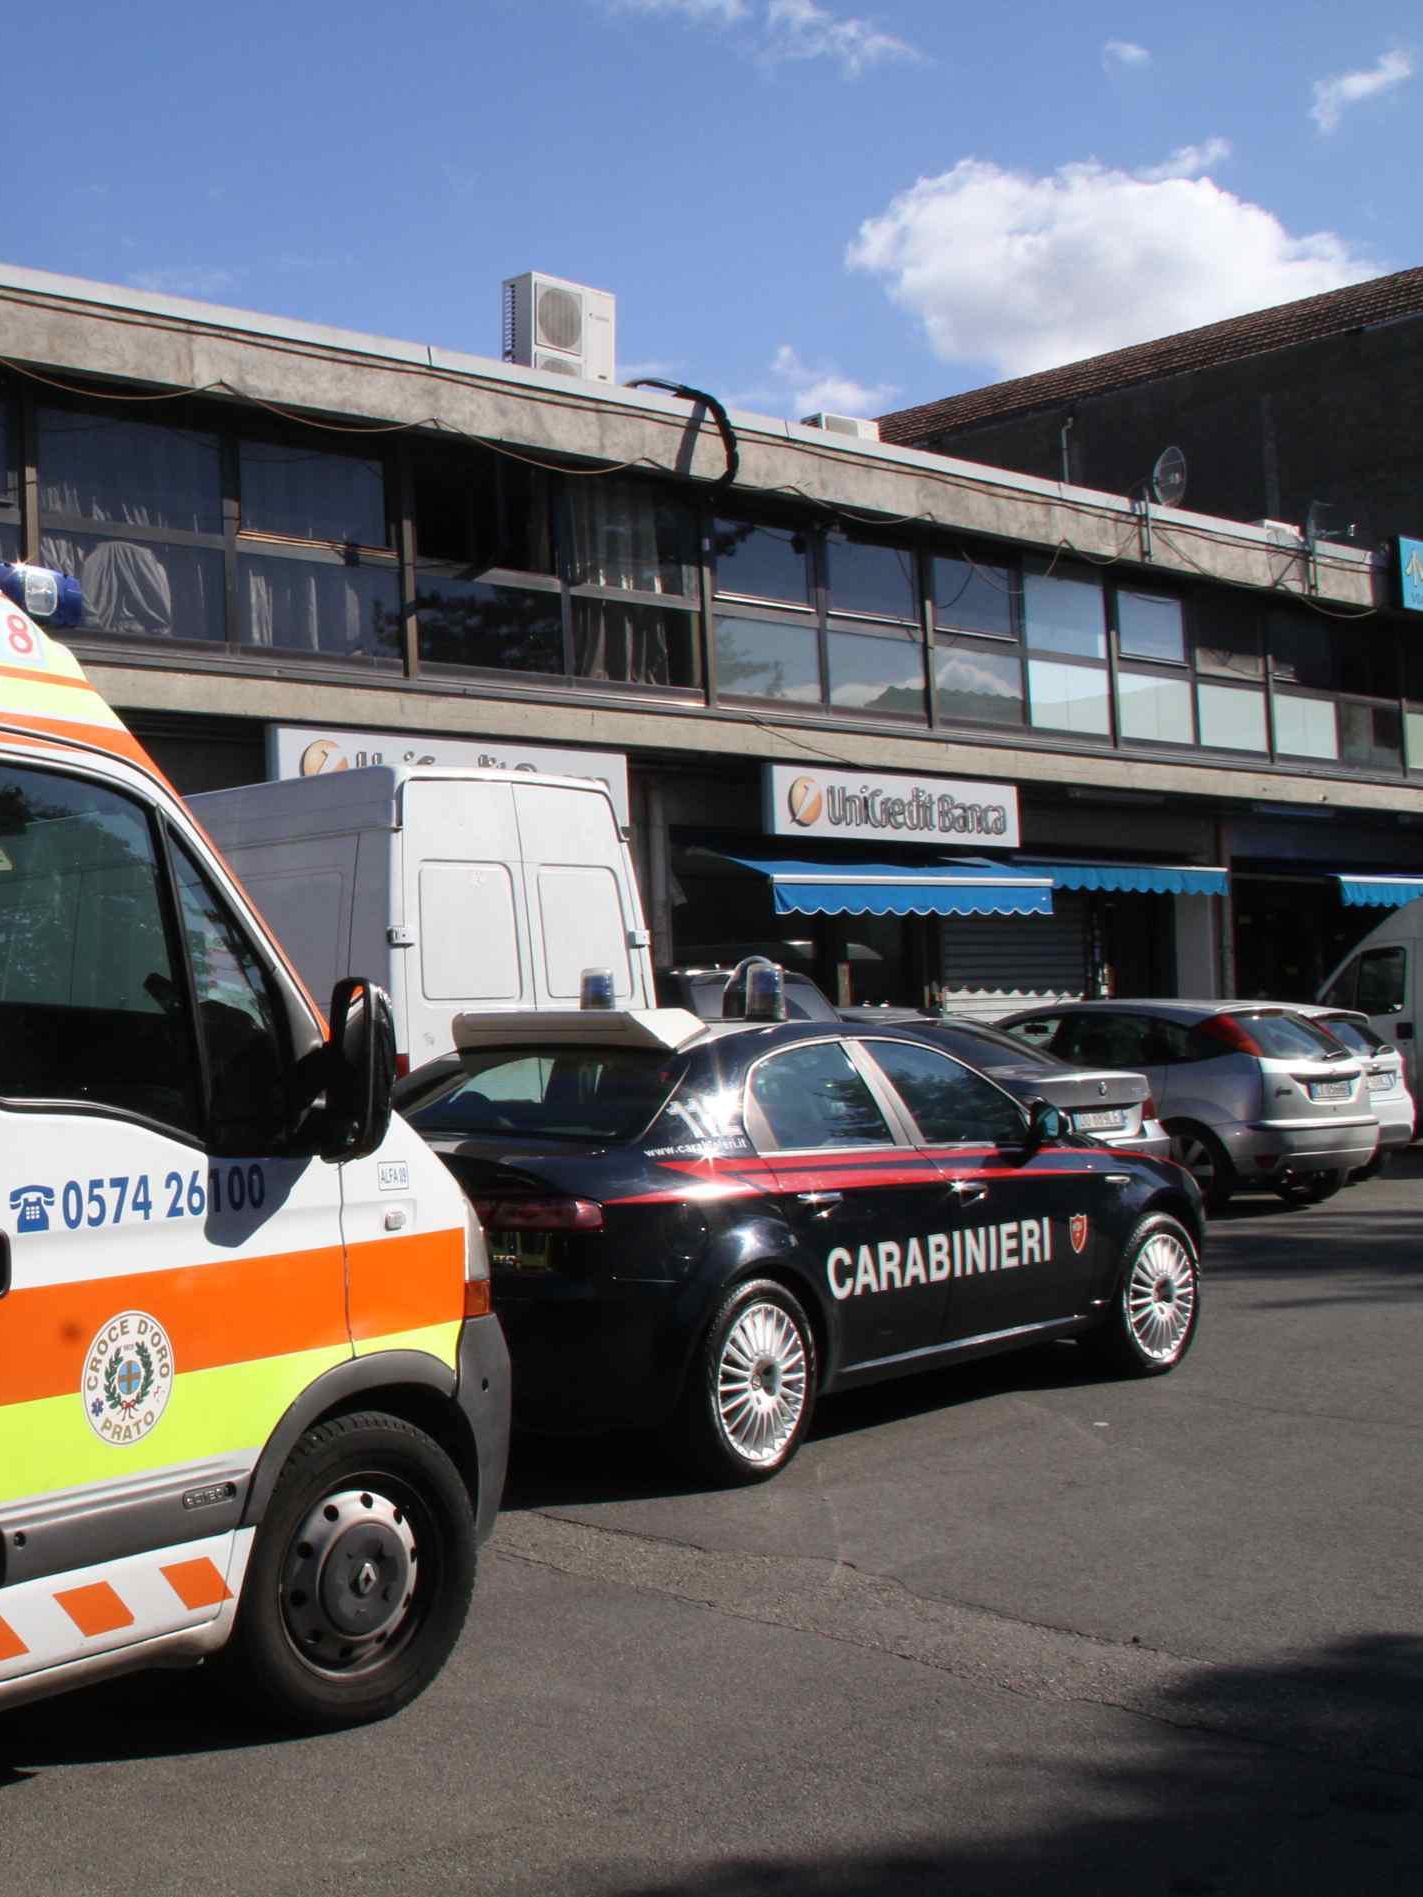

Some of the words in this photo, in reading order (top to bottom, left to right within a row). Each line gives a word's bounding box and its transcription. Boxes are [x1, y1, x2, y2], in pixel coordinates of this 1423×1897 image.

[827, 784, 936, 832] UniCredit
[937, 794, 1007, 835] Banca
[61, 1174, 153, 1231] 0574
[381, 1168, 398, 1184] ALFA
[826, 1216, 1053, 1300] CARABINIERI
[87, 1318, 130, 1391] CROCE
[136, 1319, 170, 1379] D'ORO
[100, 1410, 155, 1442] PRATO
